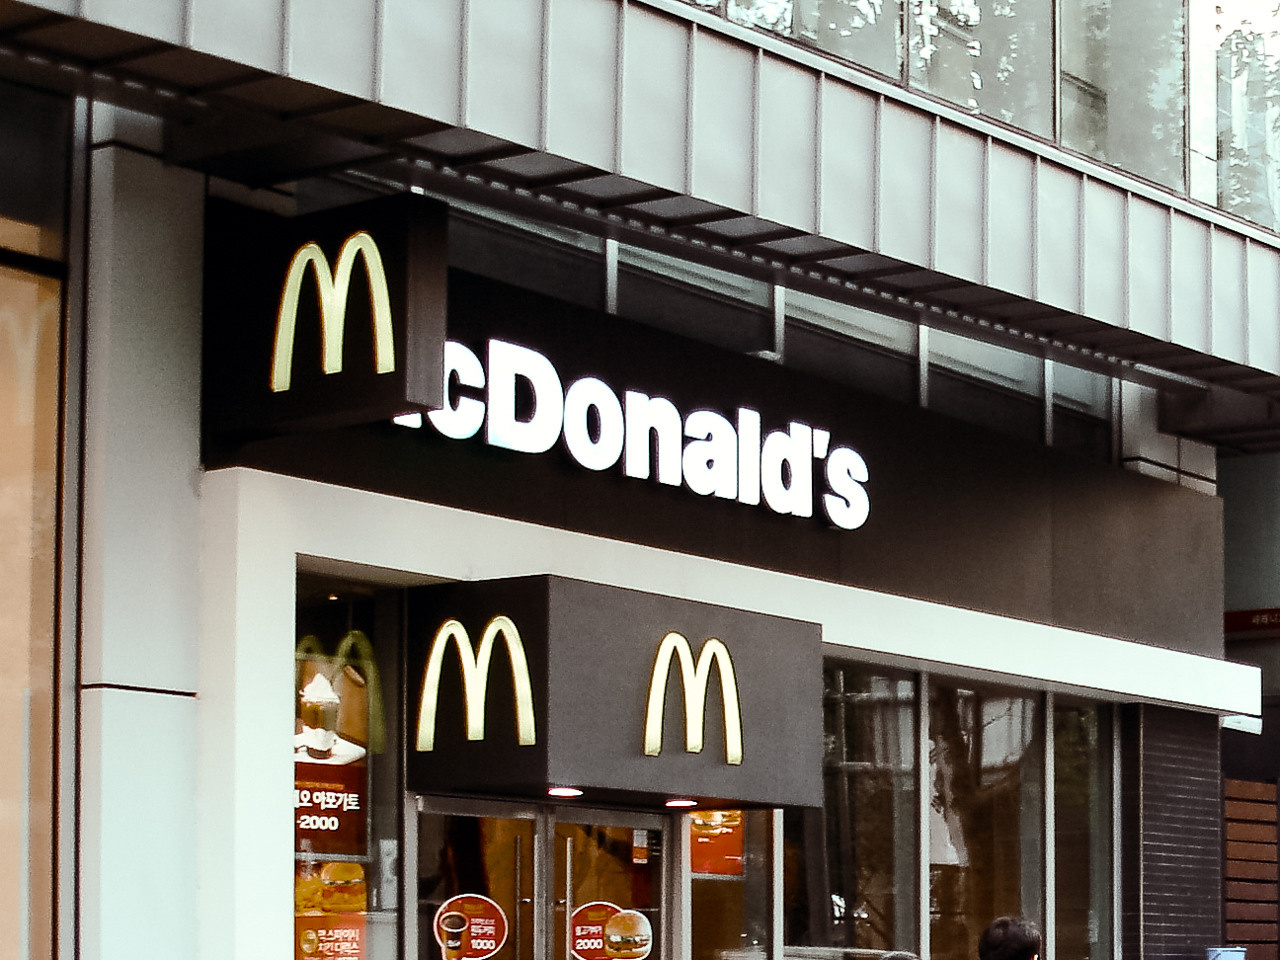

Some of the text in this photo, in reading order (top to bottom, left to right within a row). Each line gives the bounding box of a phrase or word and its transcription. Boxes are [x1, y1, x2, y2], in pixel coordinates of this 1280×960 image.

[394, 338, 870, 531] cDonald's
[470, 938, 497, 950] 1000
[575, 938, 603, 950] 2000
